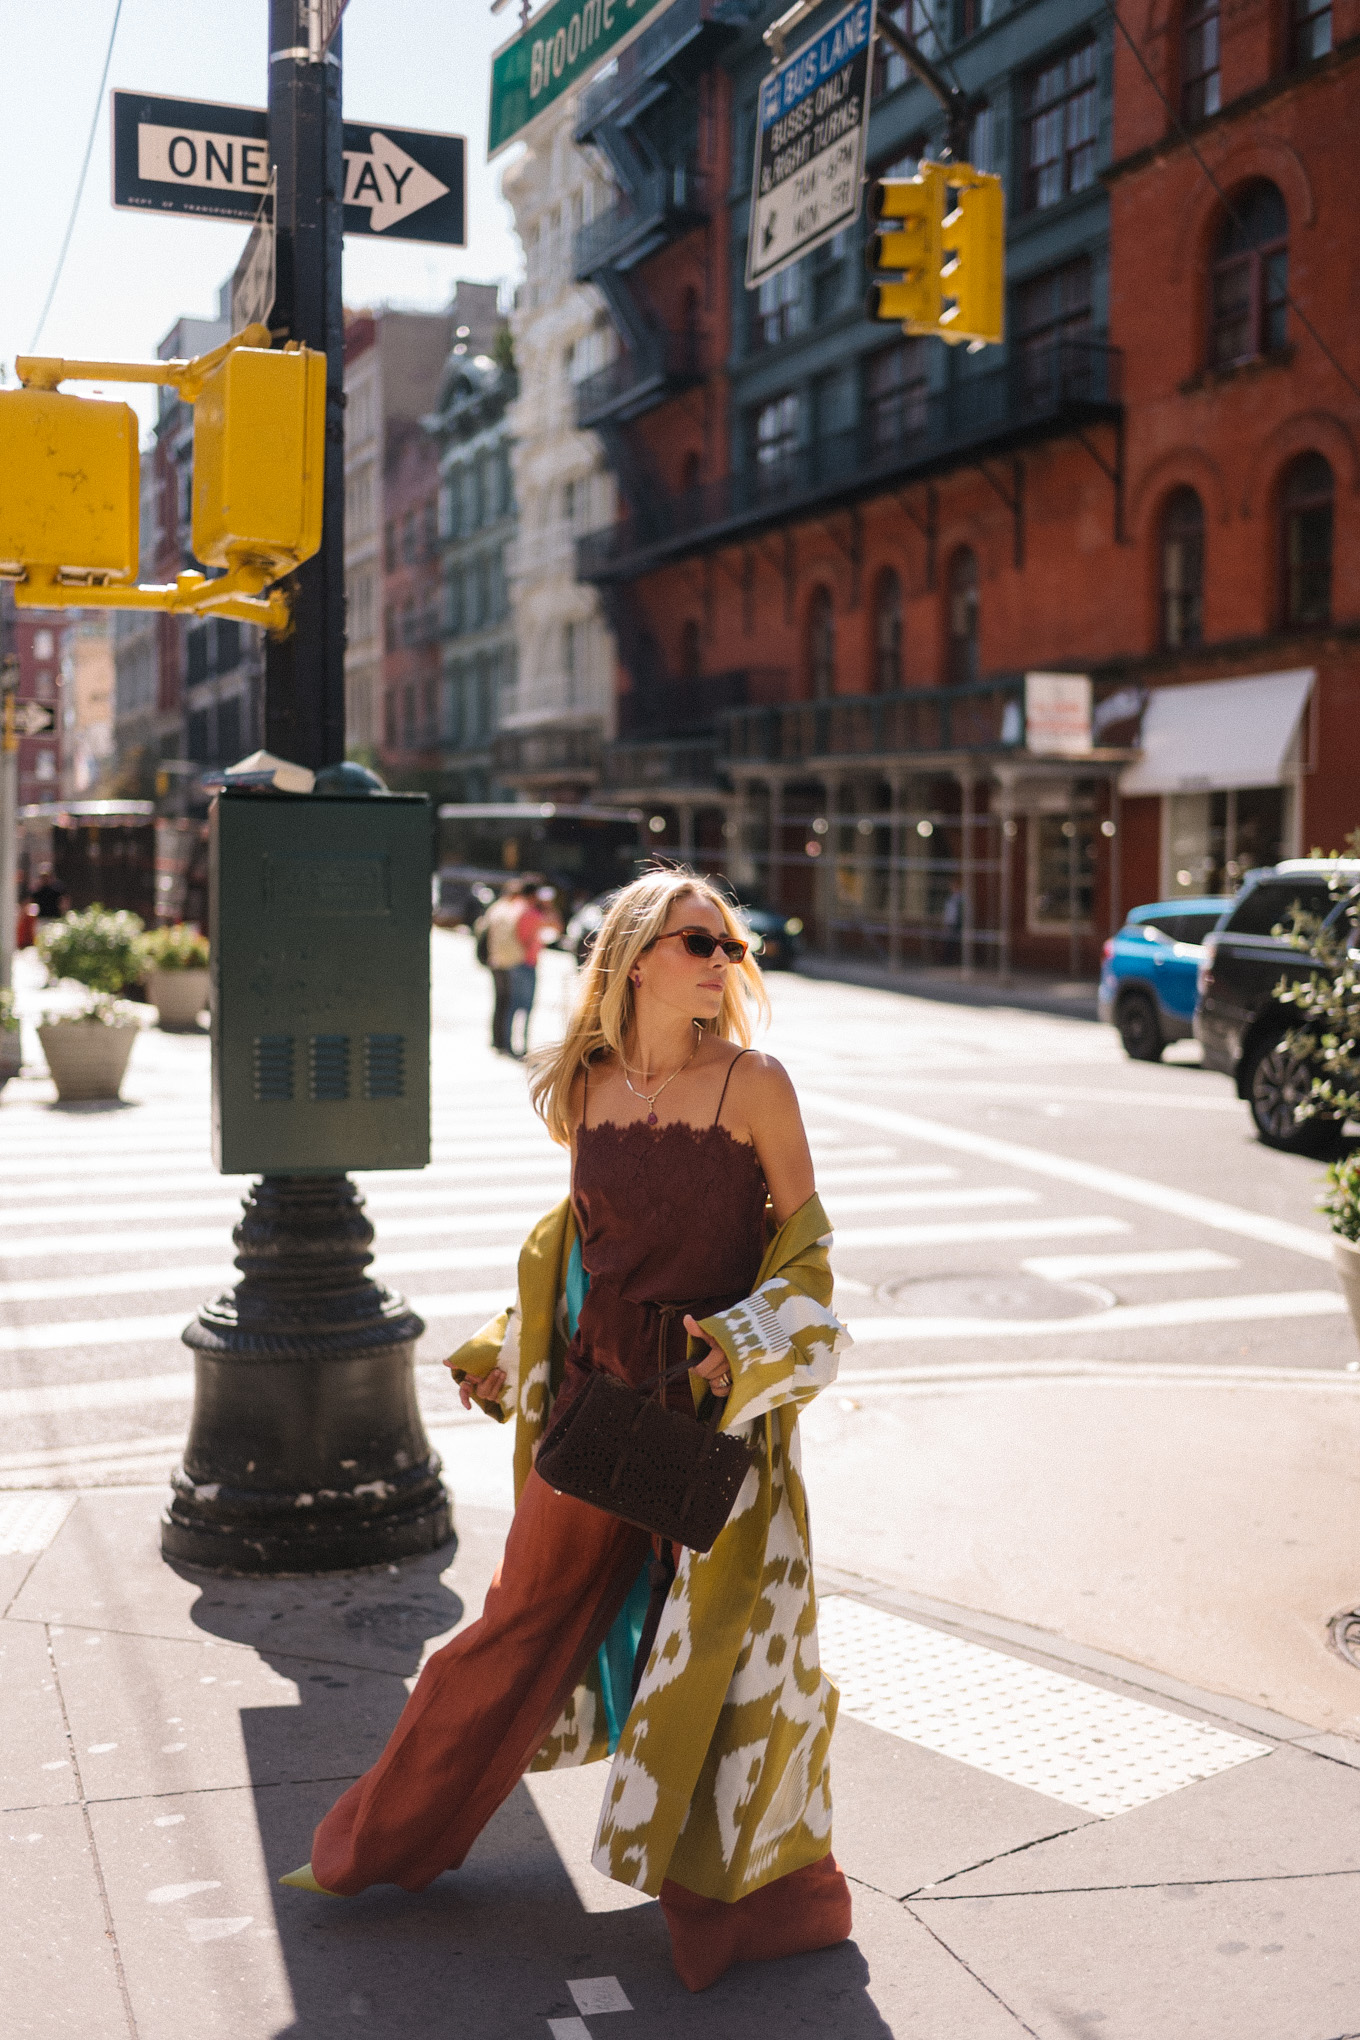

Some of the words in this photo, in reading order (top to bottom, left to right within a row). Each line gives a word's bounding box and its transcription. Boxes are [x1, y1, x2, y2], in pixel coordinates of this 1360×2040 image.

[529, 0, 616, 98] Broome
[784, 51, 818, 106] BUS
[820, 5, 868, 75] LANE
[771, 96, 814, 152] BUSES
[815, 63, 853, 116] ONLY
[813, 95, 860, 153] TURNS
[168, 135, 267, 187] ONE
[341, 158, 414, 205] AY
